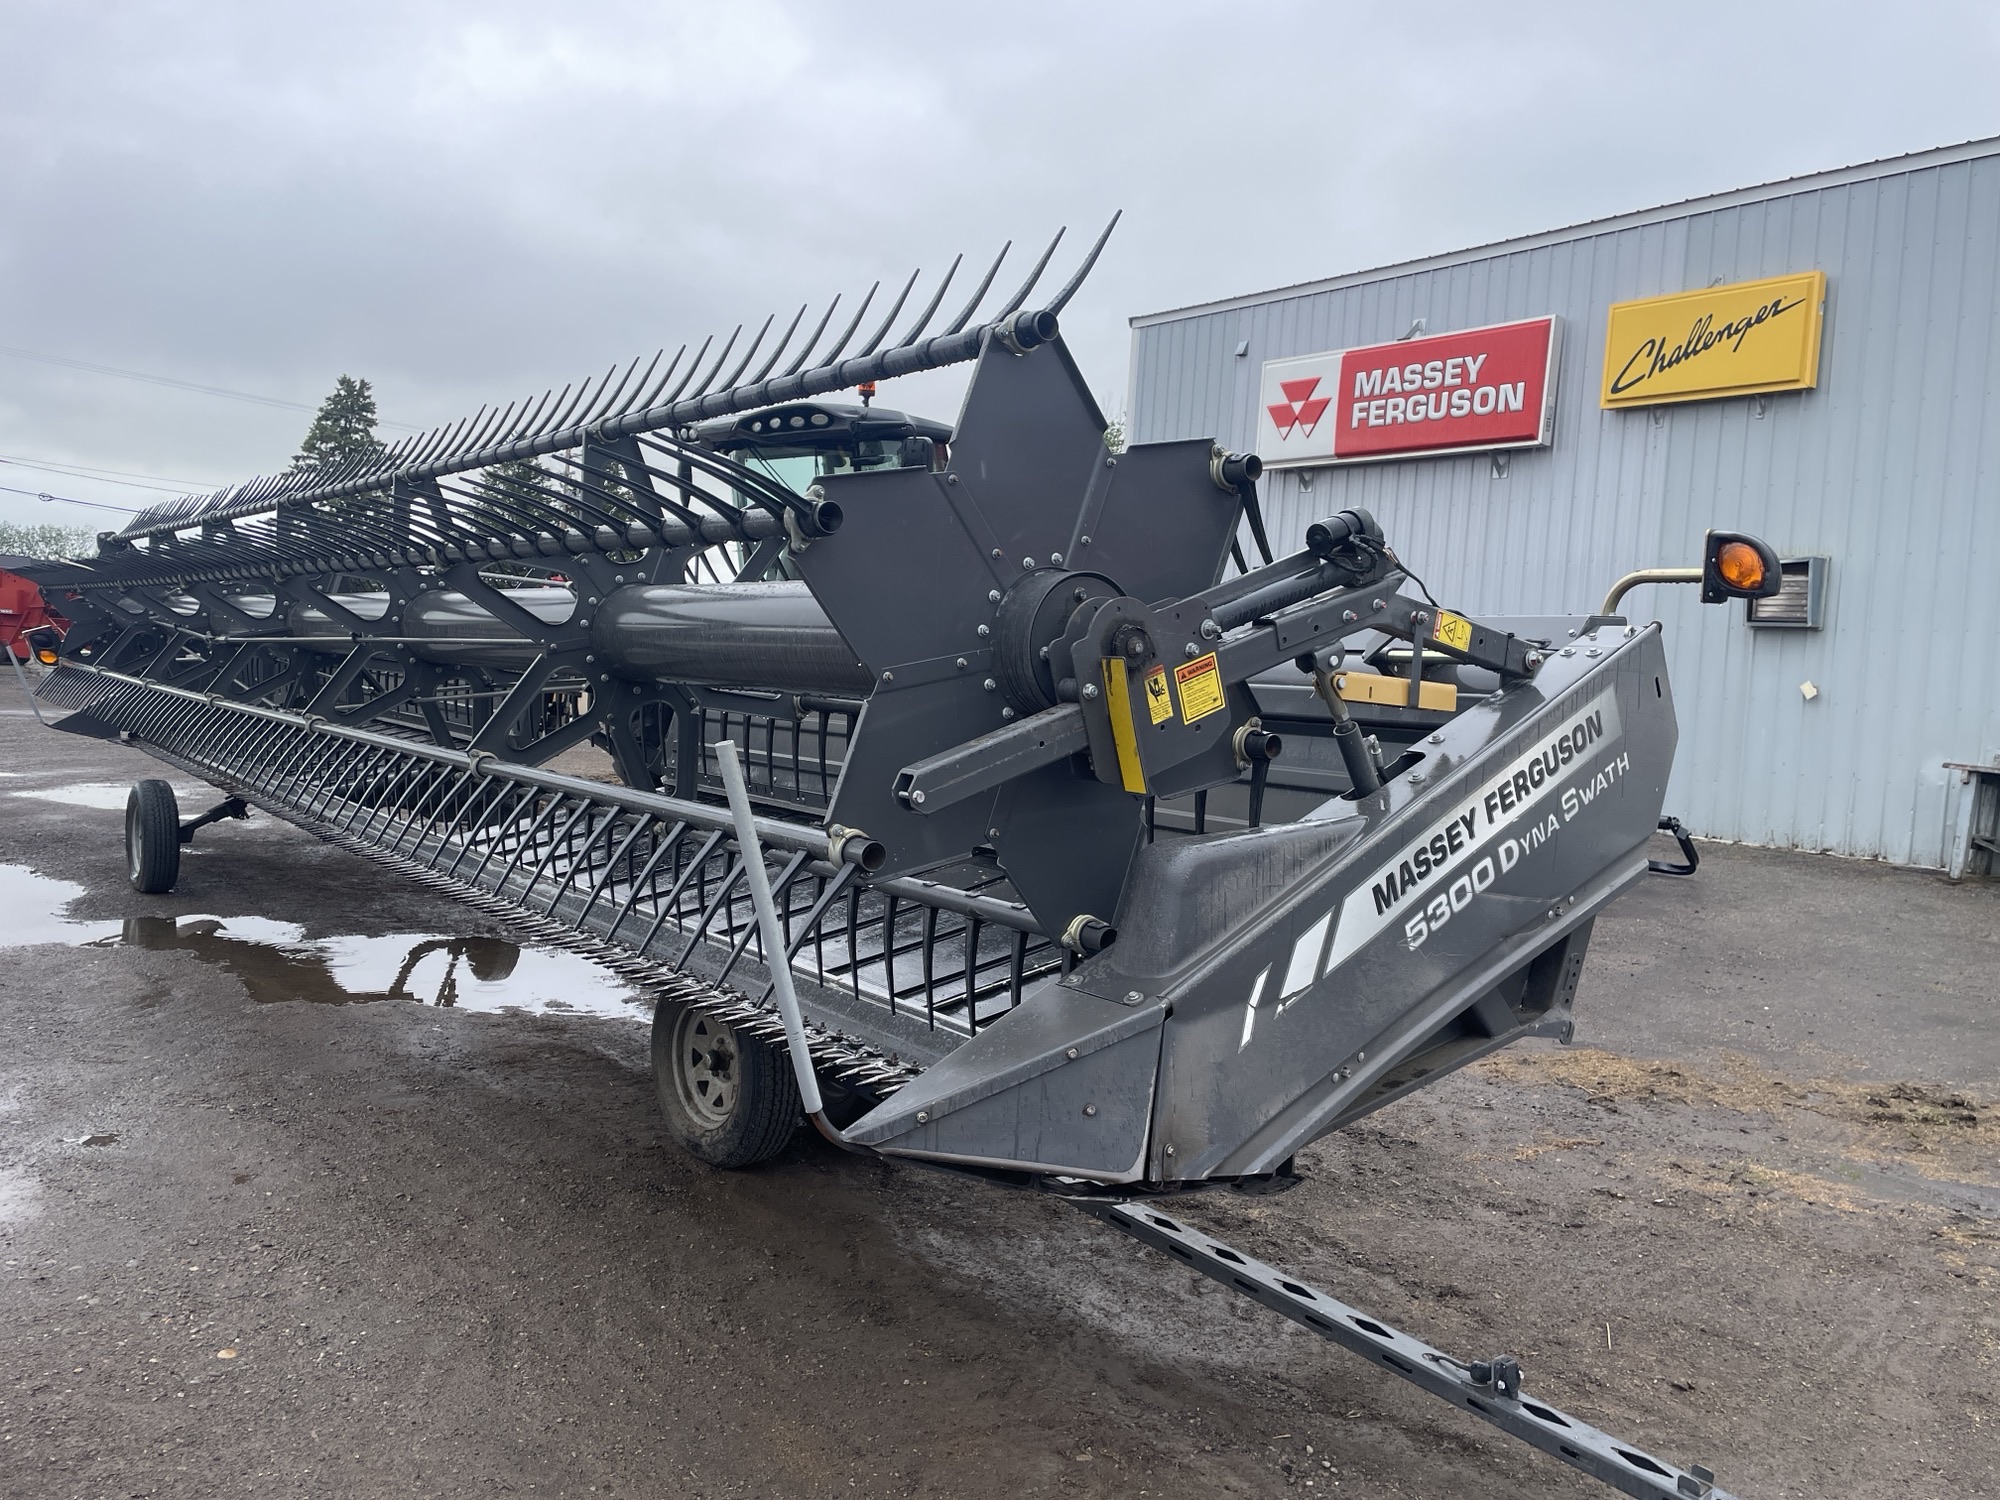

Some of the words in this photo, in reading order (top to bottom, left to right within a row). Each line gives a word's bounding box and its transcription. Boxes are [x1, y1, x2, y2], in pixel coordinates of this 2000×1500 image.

[1354, 353, 1488, 399] MASSEY
[1611, 297, 1806, 394] Challenger
[1352, 381, 1526, 429] FERGUSON
[1187, 660, 1213, 676] WARNING
[1371, 807, 1477, 917] MASSEY
[1484, 709, 1604, 825] FERGUSON
[1405, 857, 1495, 951] 5300
[1498, 813, 1560, 875] DYNA
[1561, 752, 1630, 822] SWATH
